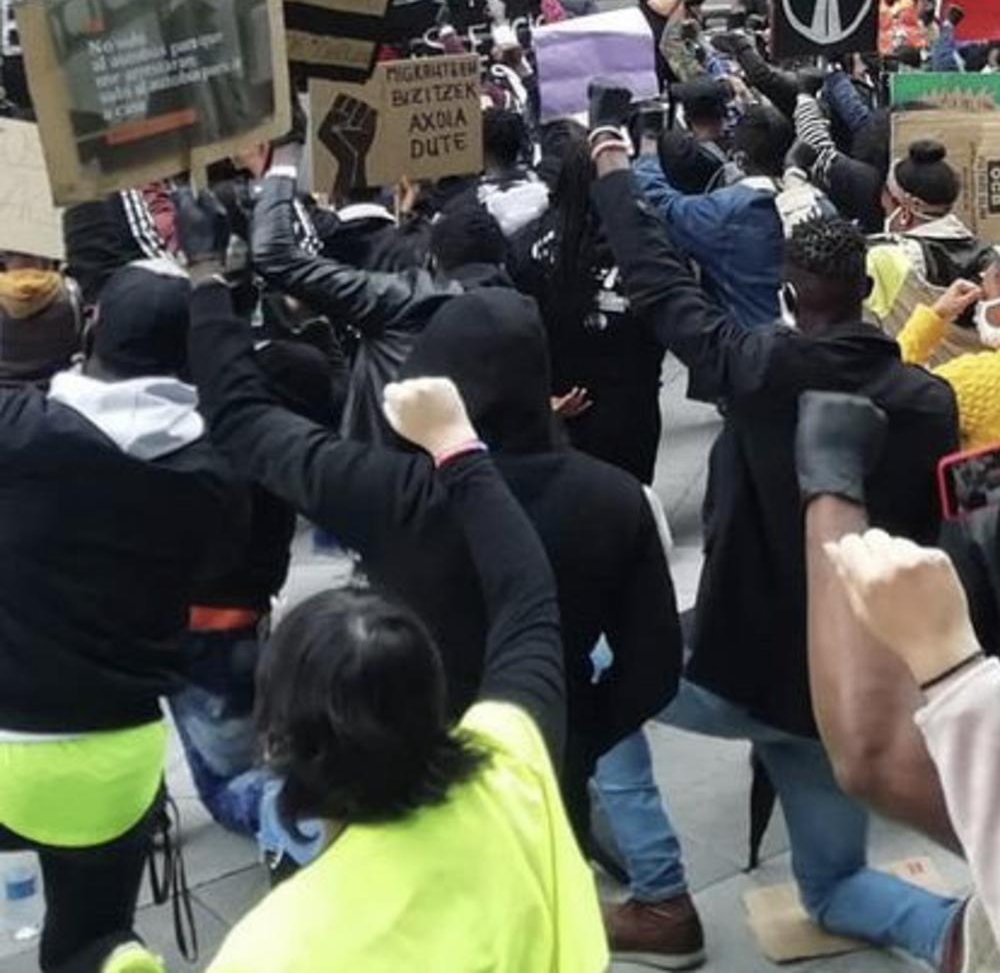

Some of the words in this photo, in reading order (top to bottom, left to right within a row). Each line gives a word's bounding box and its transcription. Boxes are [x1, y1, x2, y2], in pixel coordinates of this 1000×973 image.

[391, 82, 478, 106] BIZITZEK
[409, 108, 467, 133] AXOLA
[410, 132, 468, 160] DUTE
